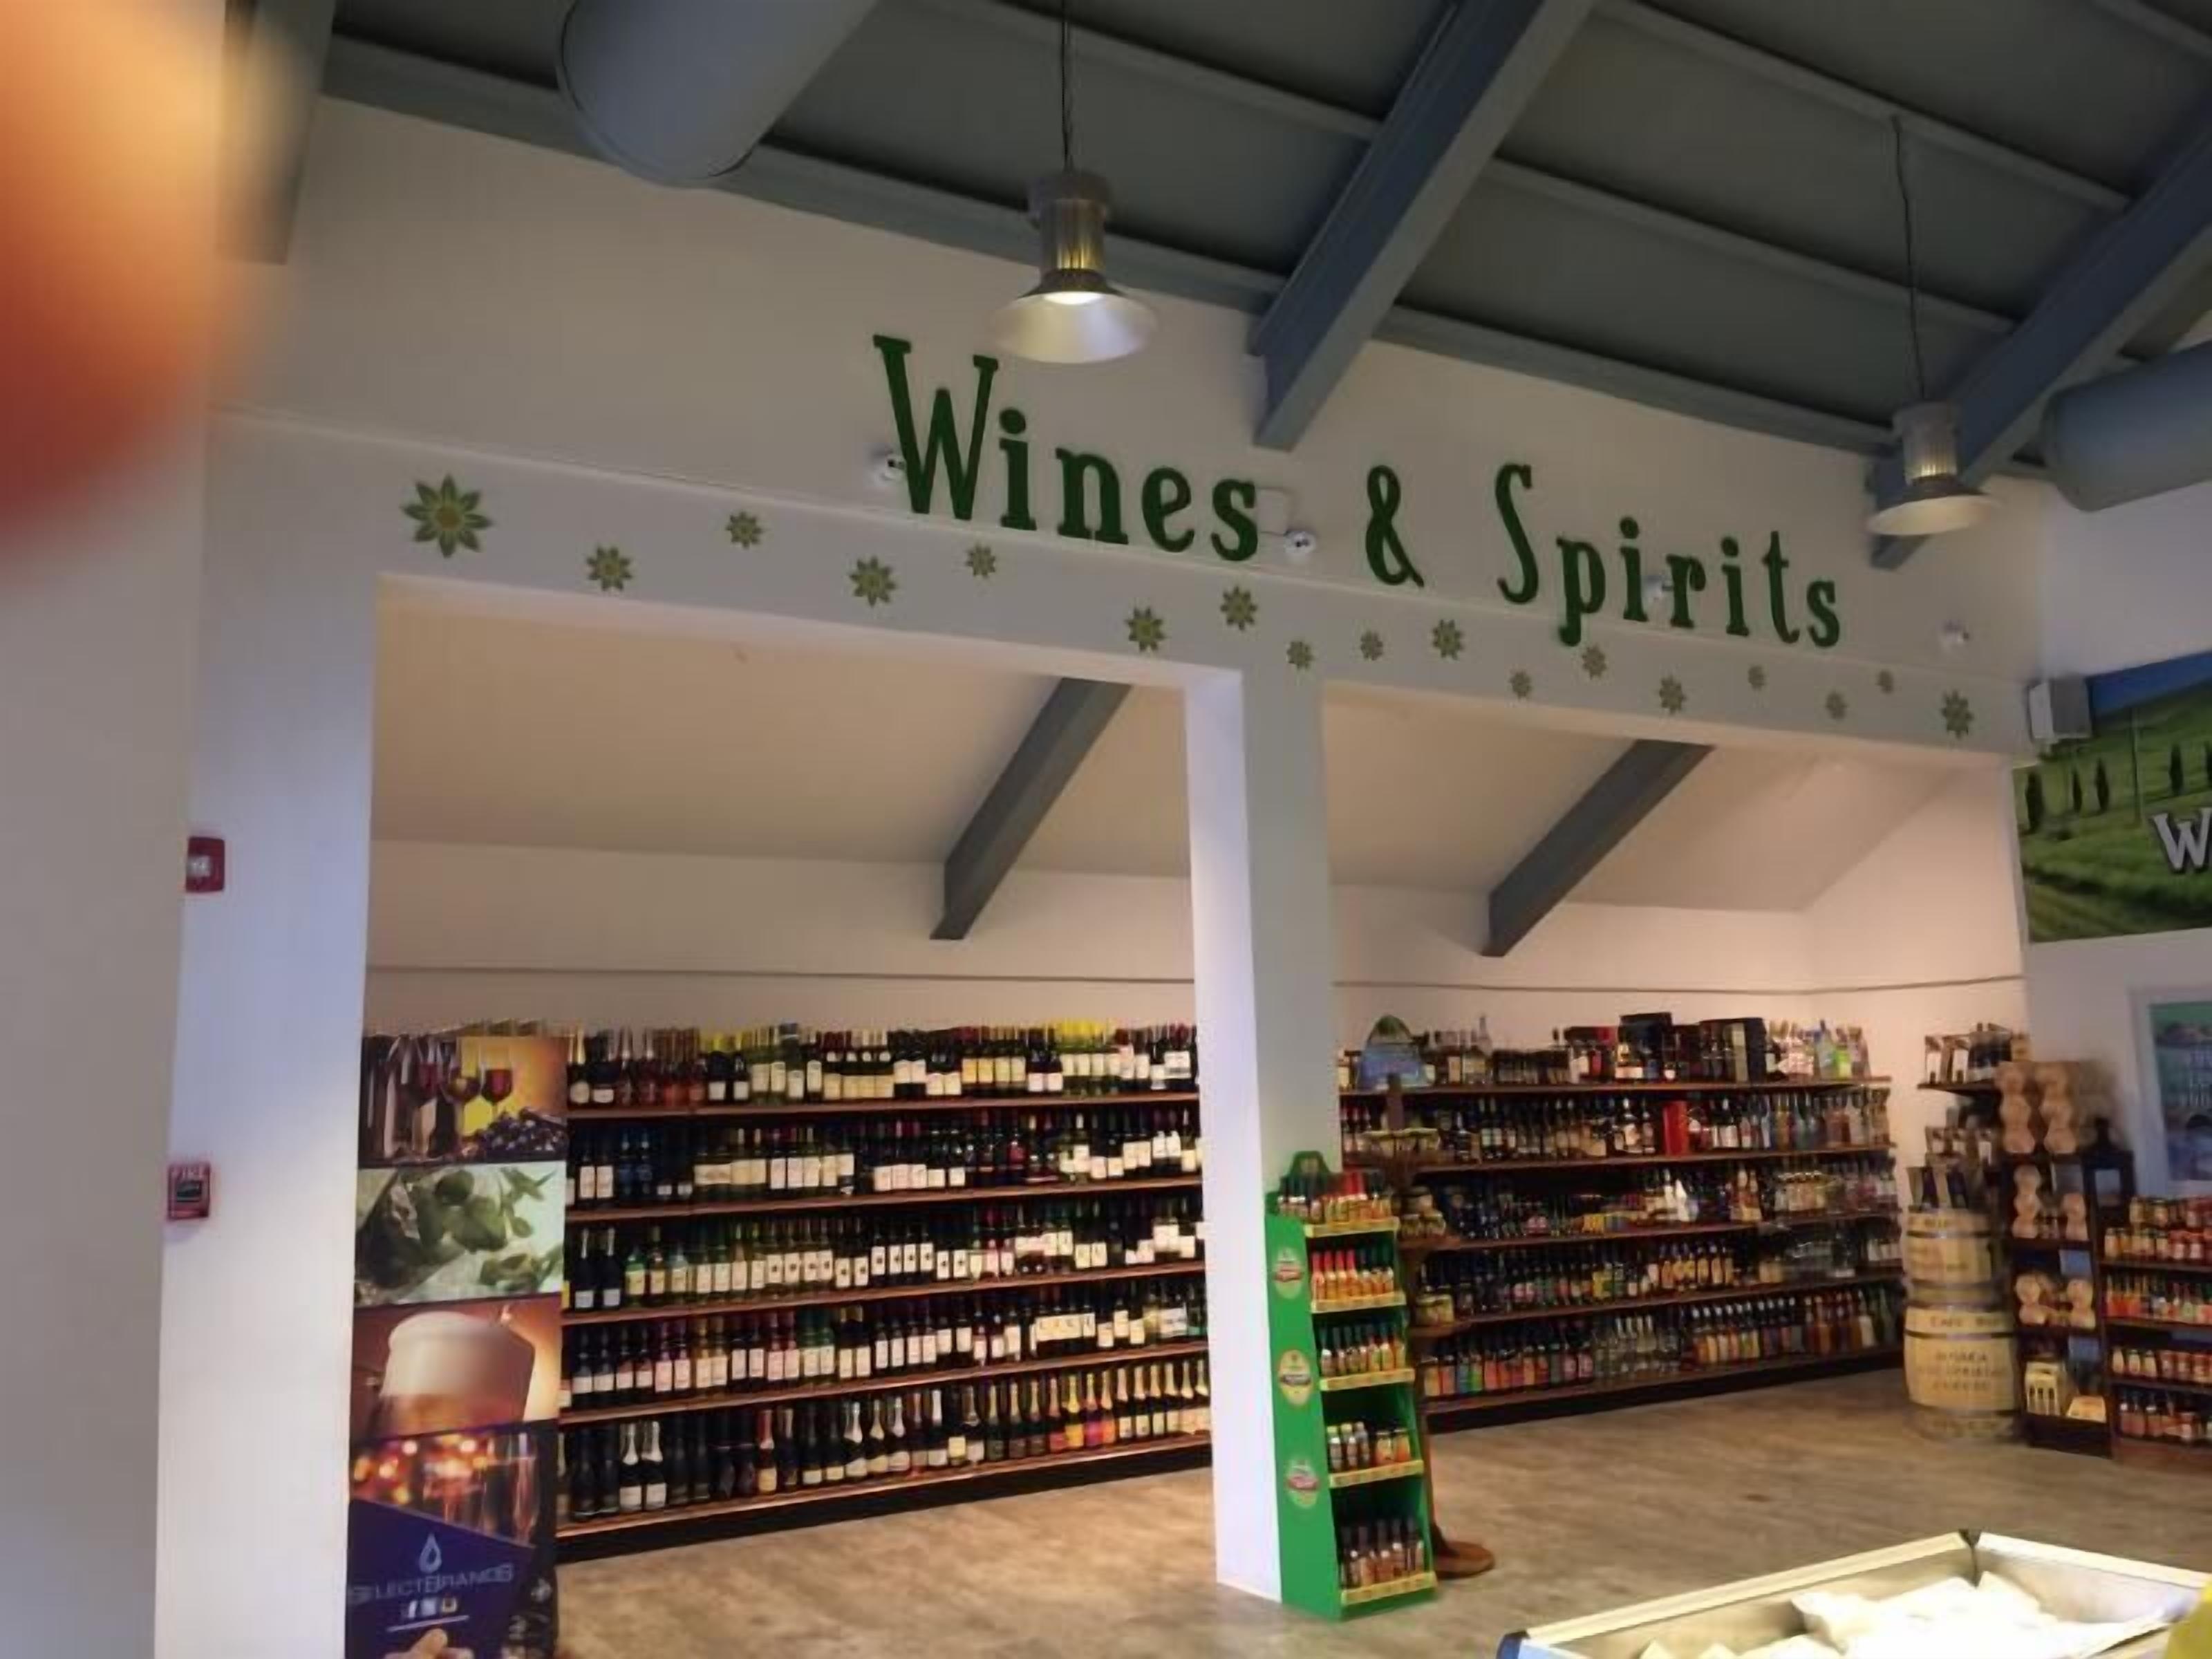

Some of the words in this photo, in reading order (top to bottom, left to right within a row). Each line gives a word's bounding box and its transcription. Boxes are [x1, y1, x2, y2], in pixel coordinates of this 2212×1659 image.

[872, 334, 1259, 562] Wines
[1365, 464, 1425, 587] &
[1495, 463, 1840, 647] Spirits
[2152, 807, 2212, 870] W
